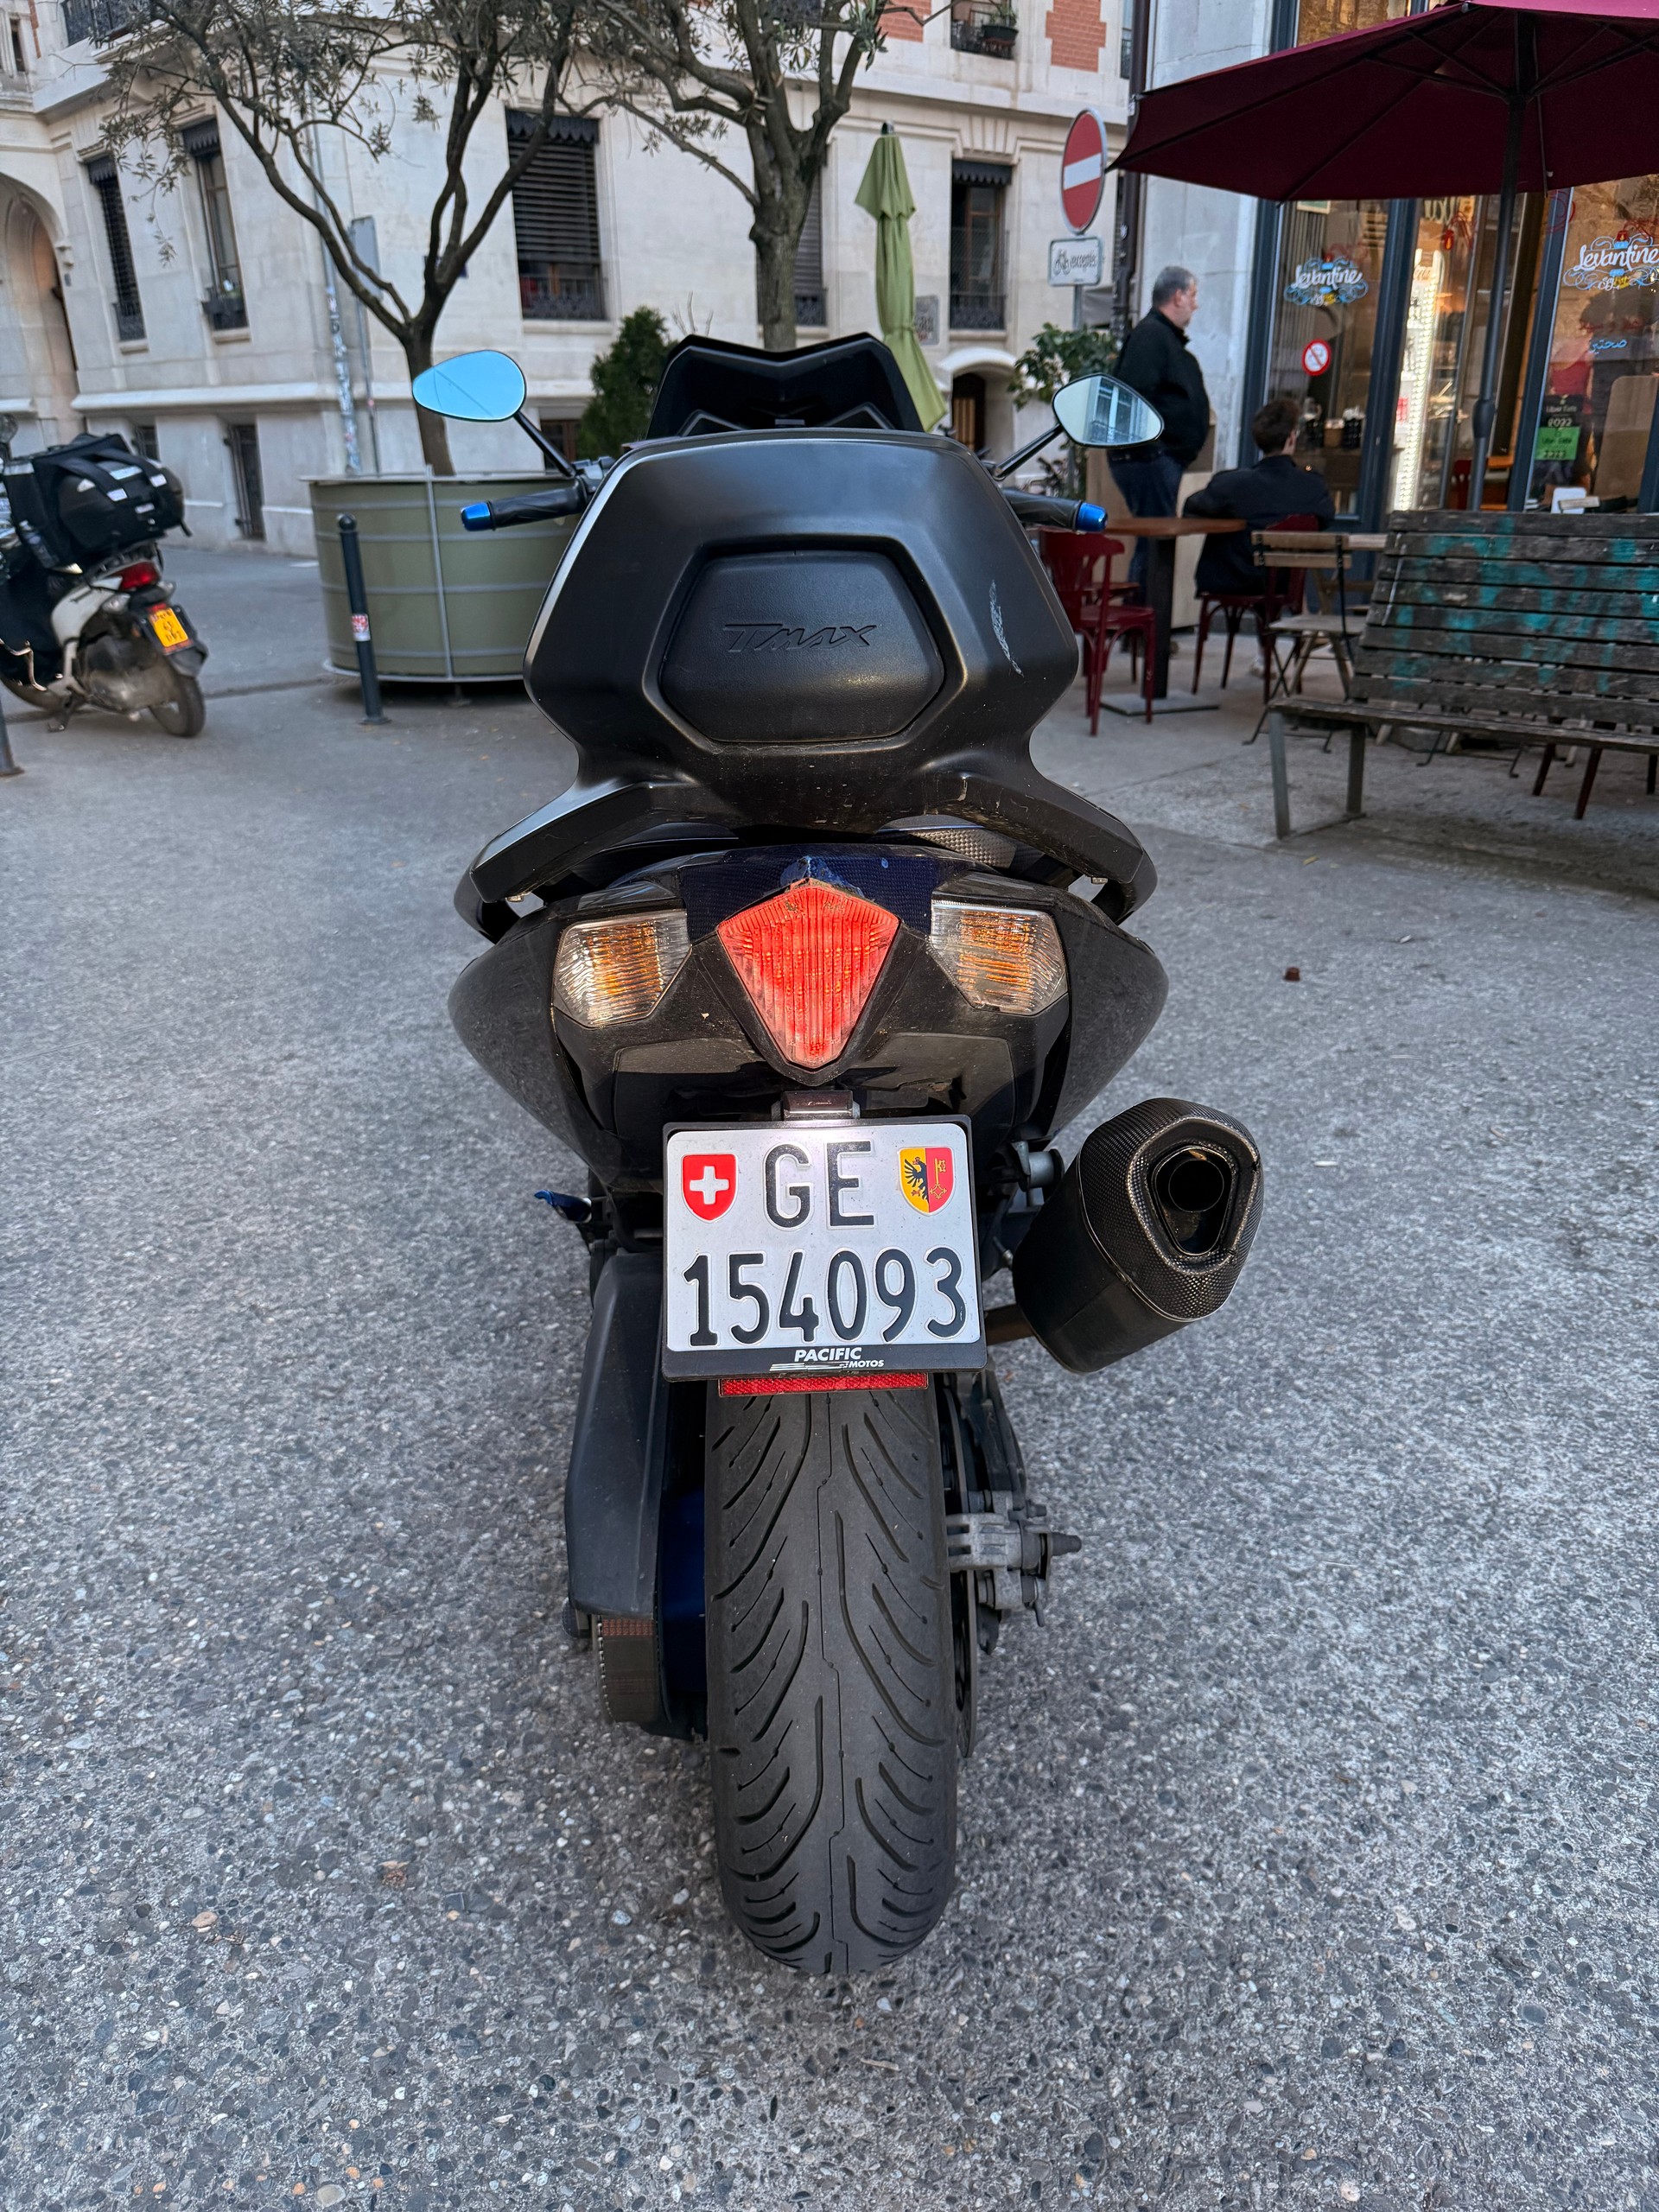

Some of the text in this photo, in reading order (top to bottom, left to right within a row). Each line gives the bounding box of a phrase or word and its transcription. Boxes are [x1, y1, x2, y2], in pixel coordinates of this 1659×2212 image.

[1573, 245, 1659, 271] Levantine
[1291, 264, 1363, 290] Levantine
[765, 1141, 875, 1228] GE
[683, 1247, 967, 1346] 154093
[794, 1347, 862, 1363] PACIFIC
[848, 1359, 885, 1368] MOTOS
